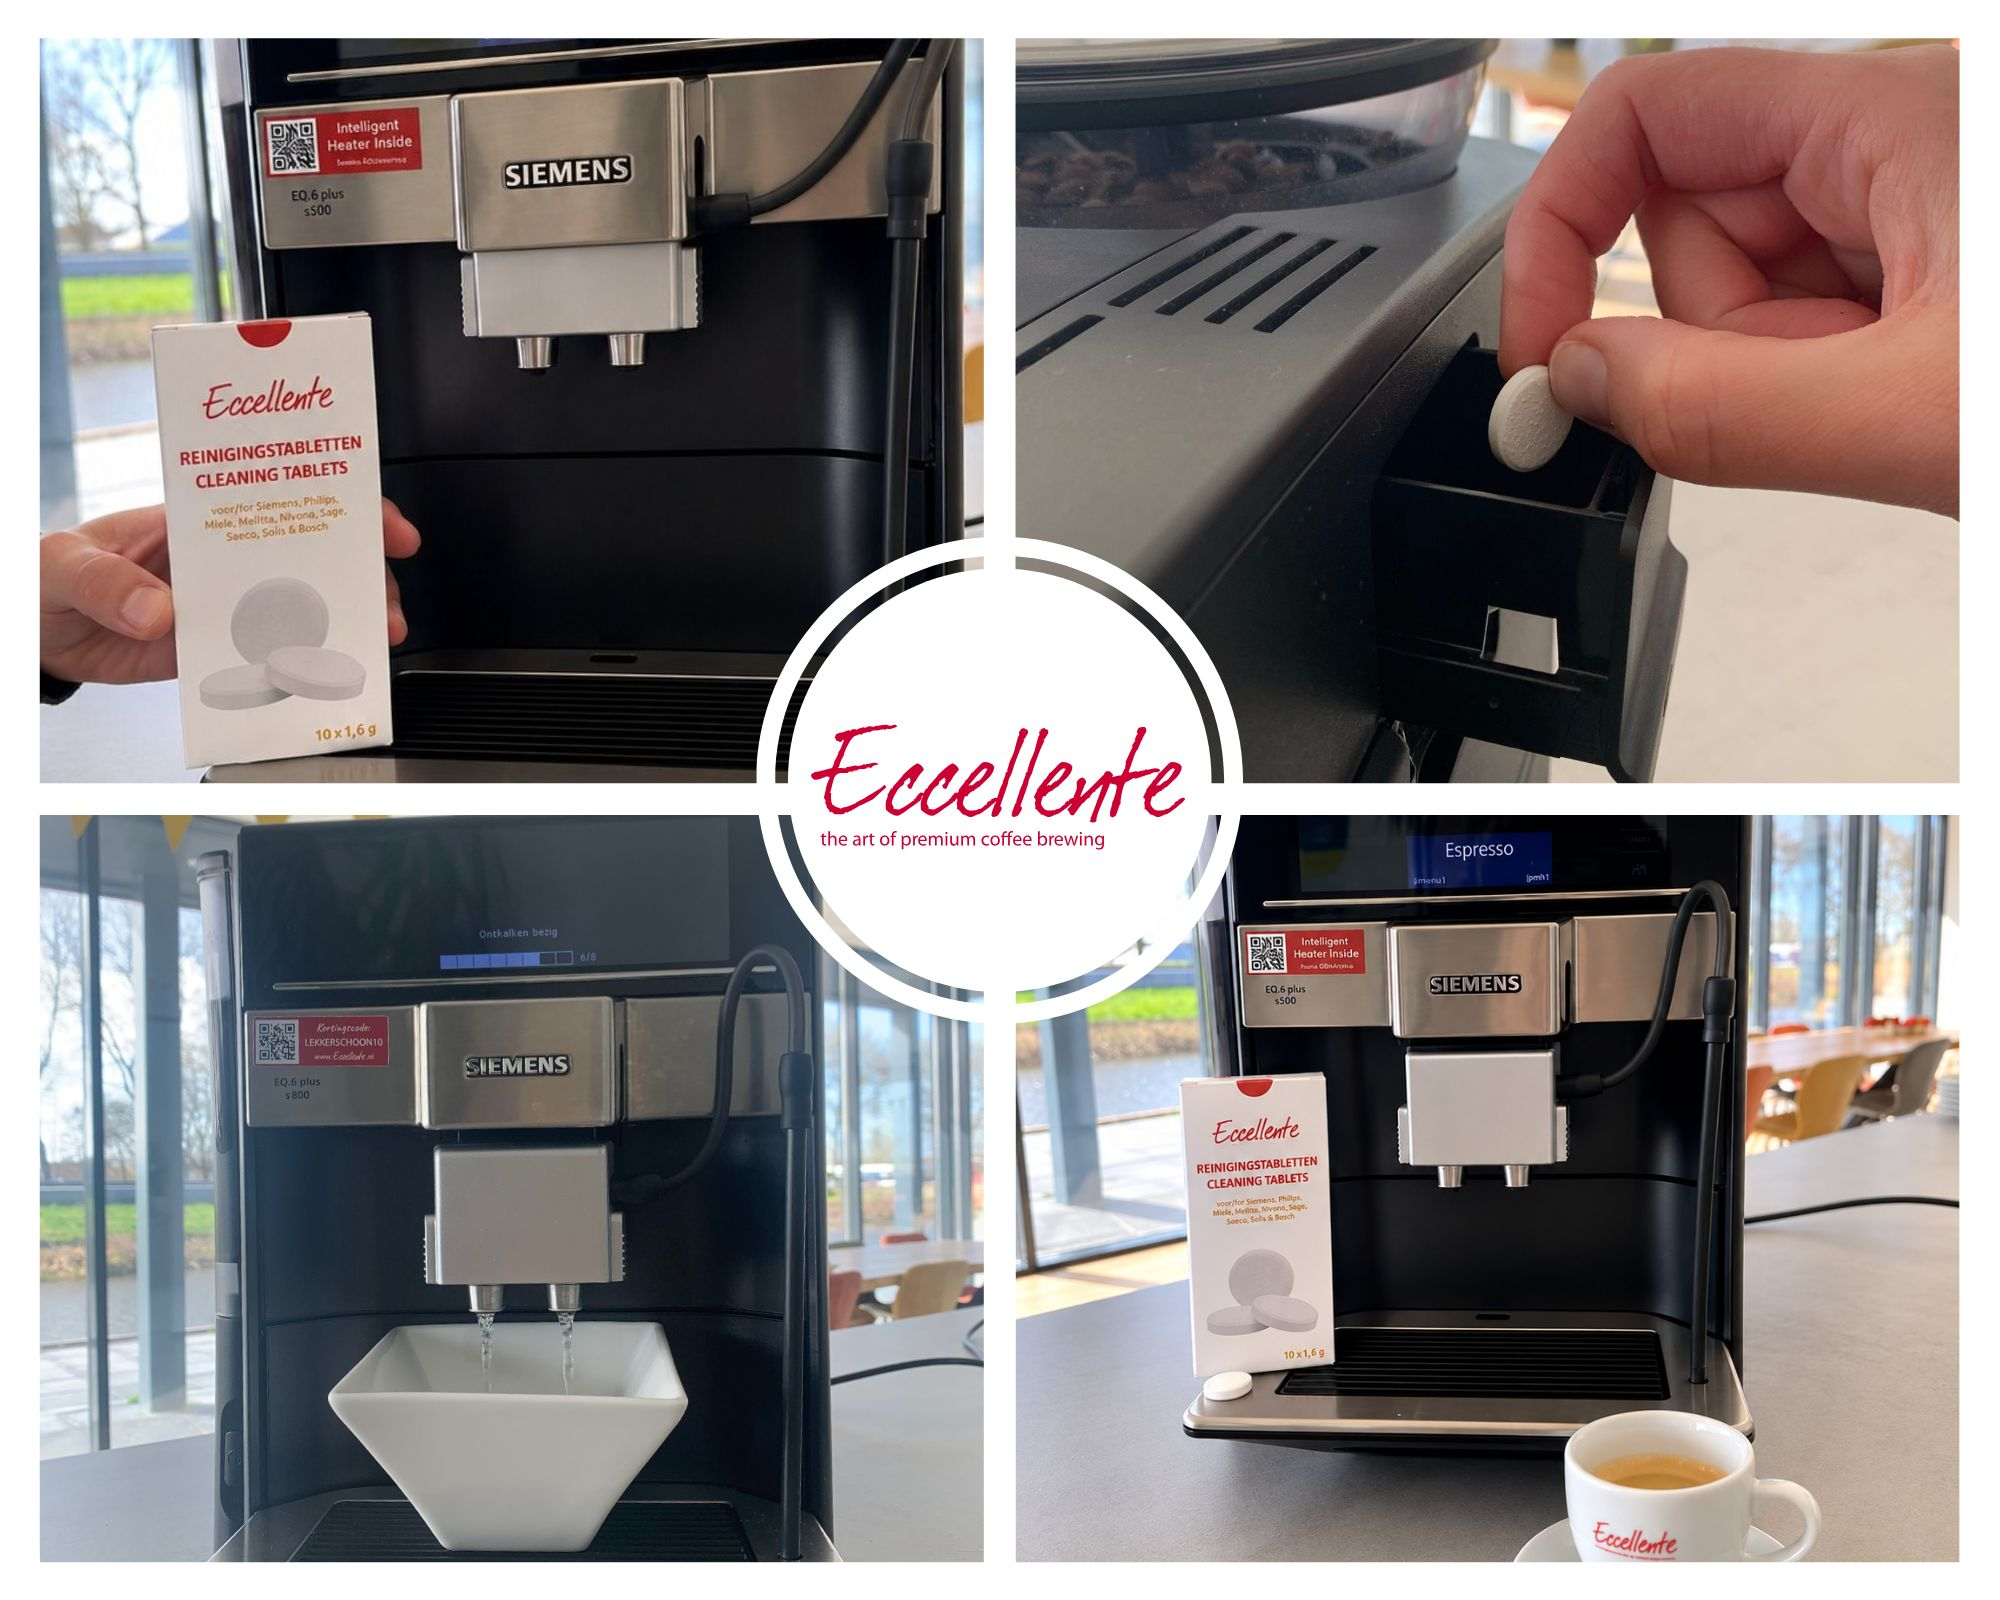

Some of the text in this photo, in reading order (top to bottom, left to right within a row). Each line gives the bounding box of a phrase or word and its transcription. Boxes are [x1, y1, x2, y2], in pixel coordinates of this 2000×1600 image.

[336, 120, 399, 135] Intelligent
[327, 135, 413, 151] Heater Inside
[505, 156, 630, 187] SIEMENS
[291, 188, 345, 203] EQ.6 plus
[304, 204, 332, 216] s500
[202, 376, 335, 420] Eccellente
[180, 435, 362, 466] REINIGINGSTABLETTEN
[195, 460, 349, 489] CLEANING TABLETS
[211, 503, 253, 515] voor/for
[288, 525, 297, 534] &
[299, 522, 328, 533] Bosch
[315, 729, 331, 740] 10
[344, 724, 365, 739] 1,6
[368, 724, 377, 737] g
[1445, 842, 1514, 861] Espresso
[479, 928, 558, 939] Ontkalken bezig
[1301, 937, 1349, 948] Intelligent
[580, 953, 597, 962] 6/8
[1293, 948, 1360, 959] Heater Inside
[1265, 984, 1306, 995] EQ.6 plus
[1430, 975, 1520, 993] SIEMENS
[1275, 996, 1297, 1005] s500
[304, 1038, 383, 1047] LEKKERSCHOON10
[466, 1056, 568, 1076] SIEMENS
[274, 1077, 321, 1088] EQ.6 plus
[1212, 1116, 1300, 1144] Eccellente
[1196, 1156, 1318, 1174] REINIGINGSTABLETTEN
[1206, 1172, 1309, 1190] CLEANING TABLETS
[1284, 1350, 1295, 1359] 10
[1303, 1348, 1317, 1359] 1,6
[1318, 1349, 1325, 1358] g
[1593, 1522, 1678, 1554] Eccellente
